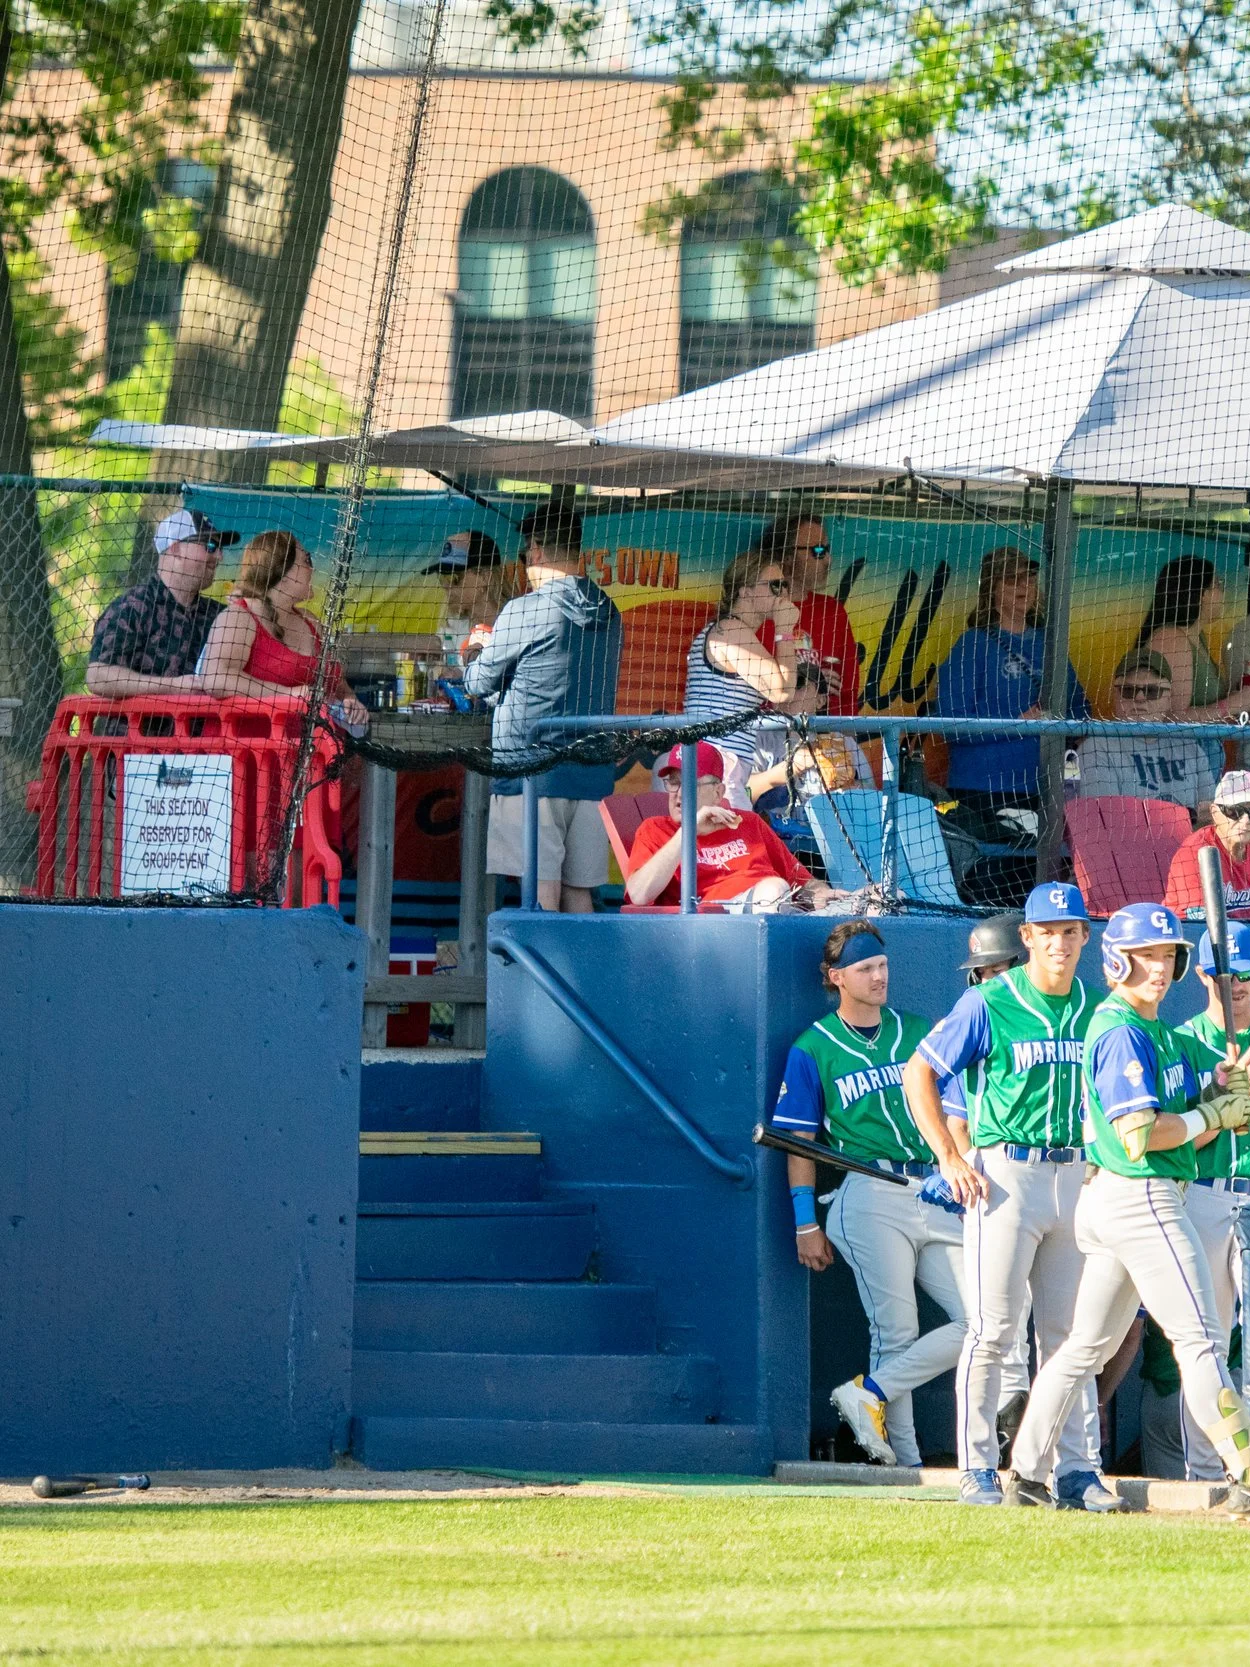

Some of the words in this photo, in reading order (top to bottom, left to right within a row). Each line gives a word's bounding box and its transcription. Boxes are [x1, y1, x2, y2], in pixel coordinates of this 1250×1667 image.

[618, 547, 680, 590] OWN
[145, 800, 165, 816] THIS
[168, 800, 208, 816] SECTION
[140, 826, 190, 842] RESERVED
[193, 827, 212, 842] FOR
[142, 852, 177, 869] GROUP
[179, 853, 209, 869] EVENT
[1049, 889, 1068, 909] GL
[1151, 912, 1173, 935] GL
